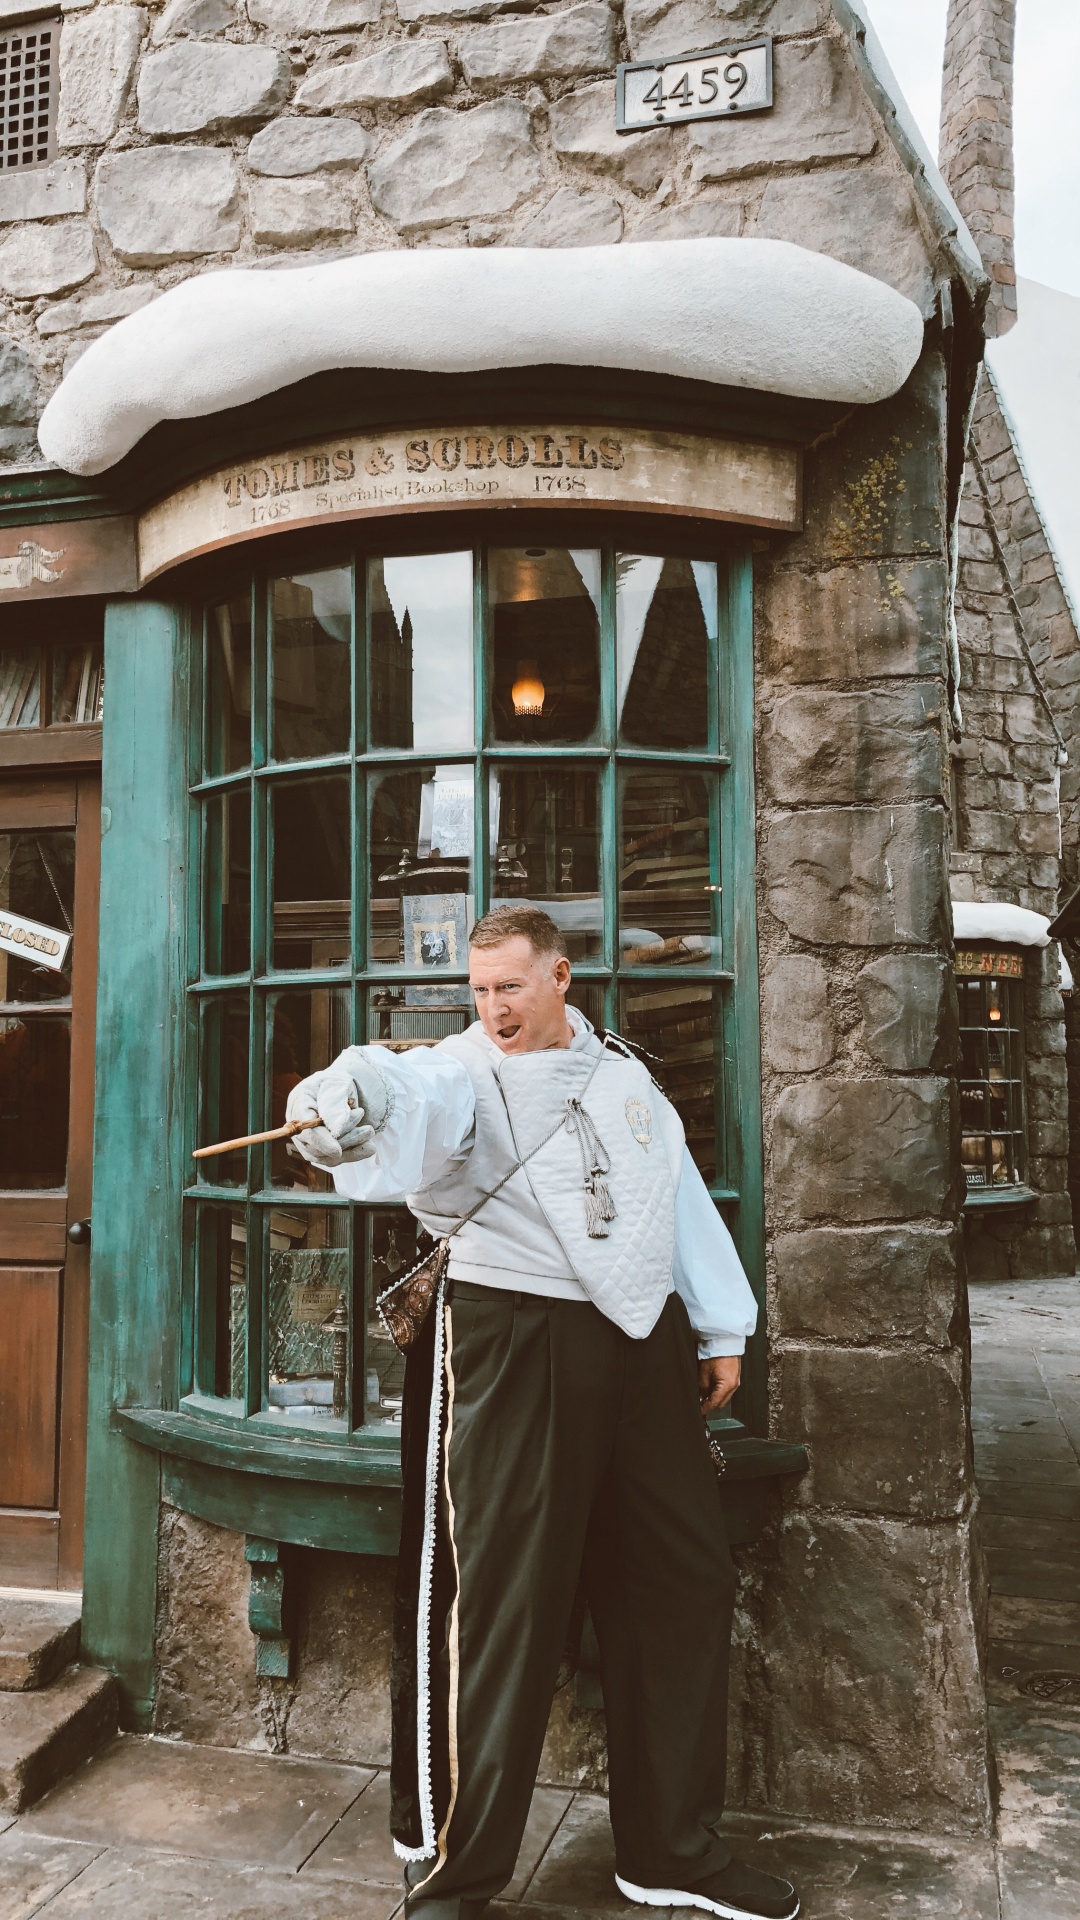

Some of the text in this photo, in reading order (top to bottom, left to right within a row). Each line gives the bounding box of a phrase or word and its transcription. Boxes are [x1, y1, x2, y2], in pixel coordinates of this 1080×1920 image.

[642, 61, 748, 111] 4459
[224, 434, 626, 509] TOMES & SCROLLS
[251, 474, 588, 525] 1768 Specialist Bookshop 1768
[0, 920, 61, 957] LOSED
